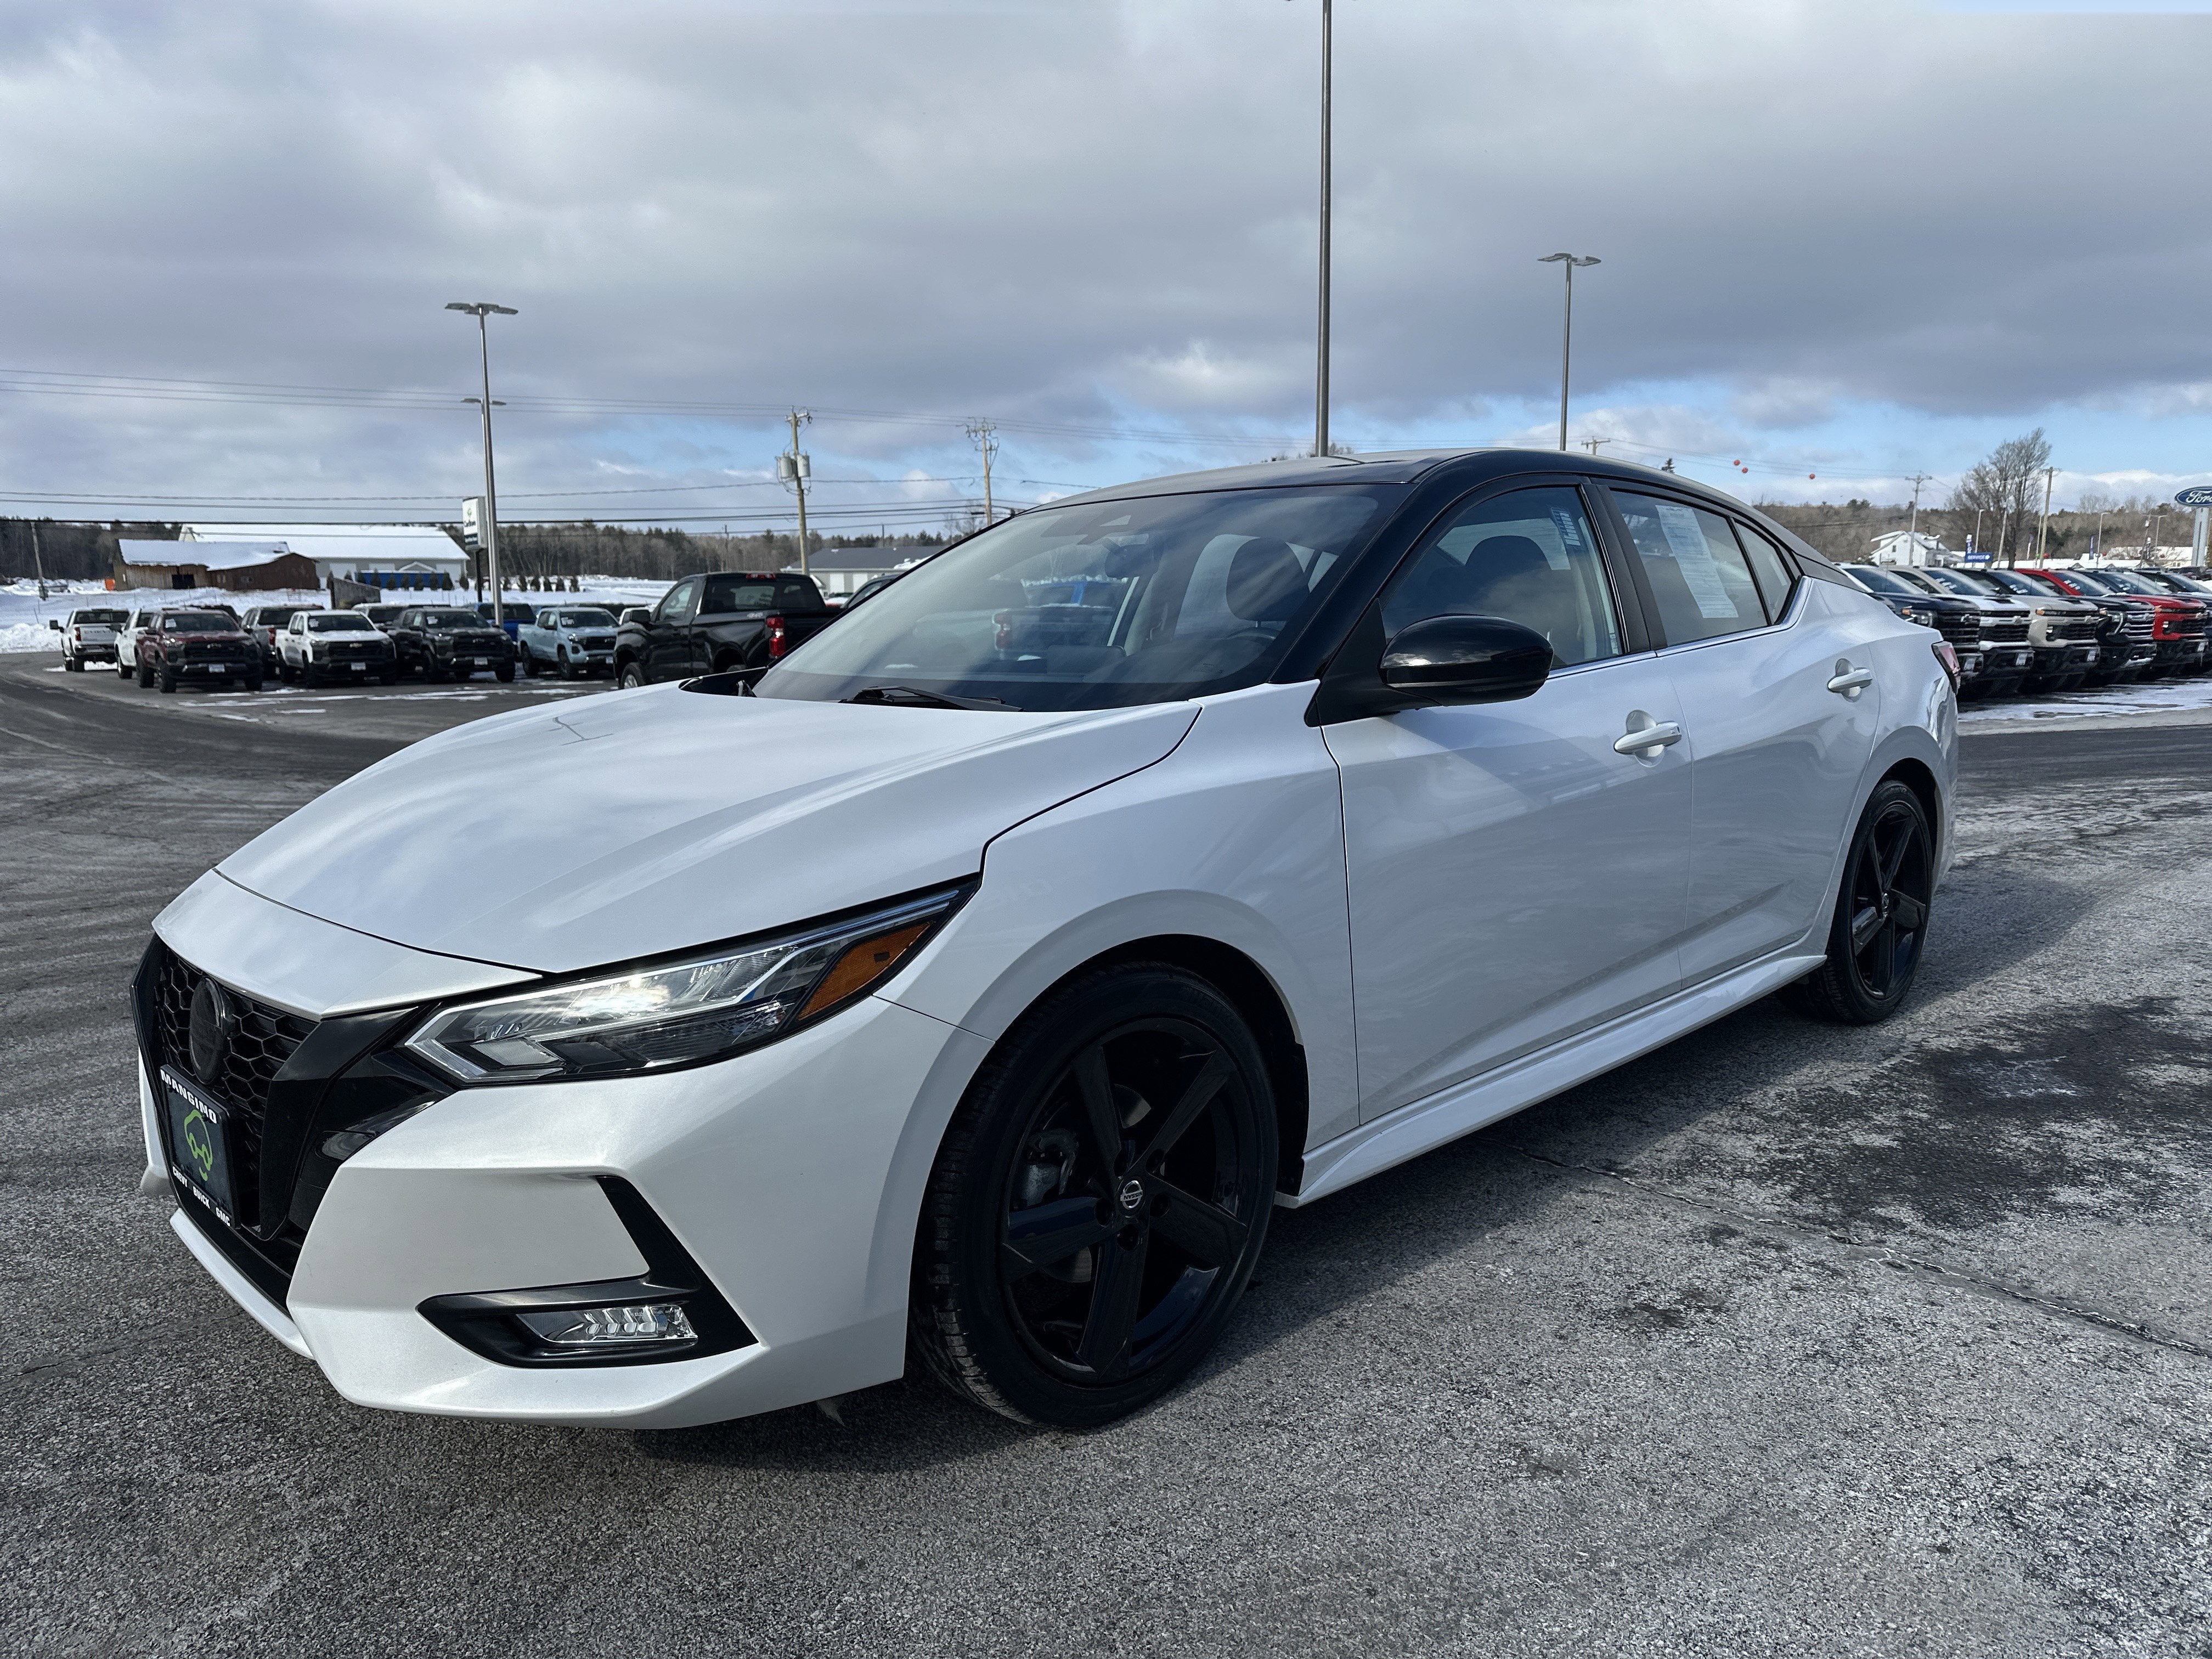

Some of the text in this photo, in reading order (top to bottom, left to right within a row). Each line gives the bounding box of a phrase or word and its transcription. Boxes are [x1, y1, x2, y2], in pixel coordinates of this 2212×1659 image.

[160, 1069, 217, 1124] MANGINO
[173, 1166, 230, 1227] CHEVY BUICK GMC
